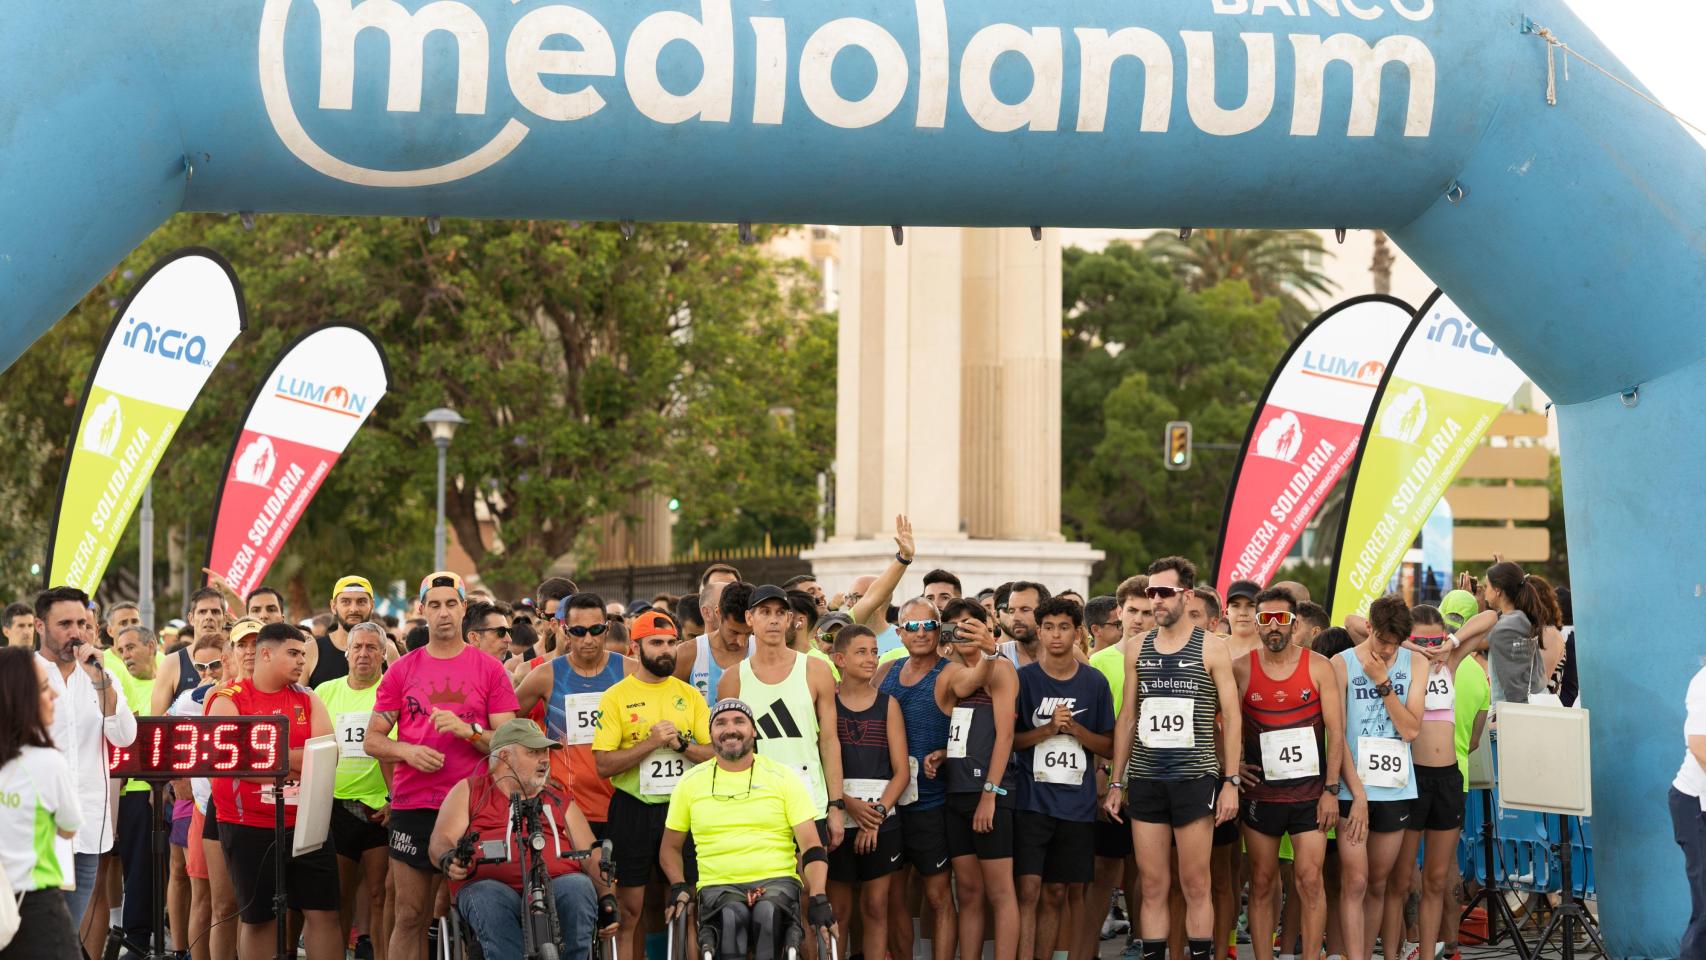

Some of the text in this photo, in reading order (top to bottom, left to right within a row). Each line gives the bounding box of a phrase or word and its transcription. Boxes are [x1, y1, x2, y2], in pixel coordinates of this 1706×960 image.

[310, 0, 1436, 138] mediolanum
[91, 427, 151, 532] SOLIDARIA
[247, 462, 305, 547] SOLIDARIA
[1349, 416, 1461, 590] CARRERA SOLIDARIA
[1231, 438, 1336, 582] CARRERA SOLIDARIA
[1149, 714, 1184, 732] 149
[651, 759, 684, 778] 213
[1044, 751, 1078, 769] 641
[1279, 745, 1303, 763] 45
[1368, 754, 1402, 772] 589
